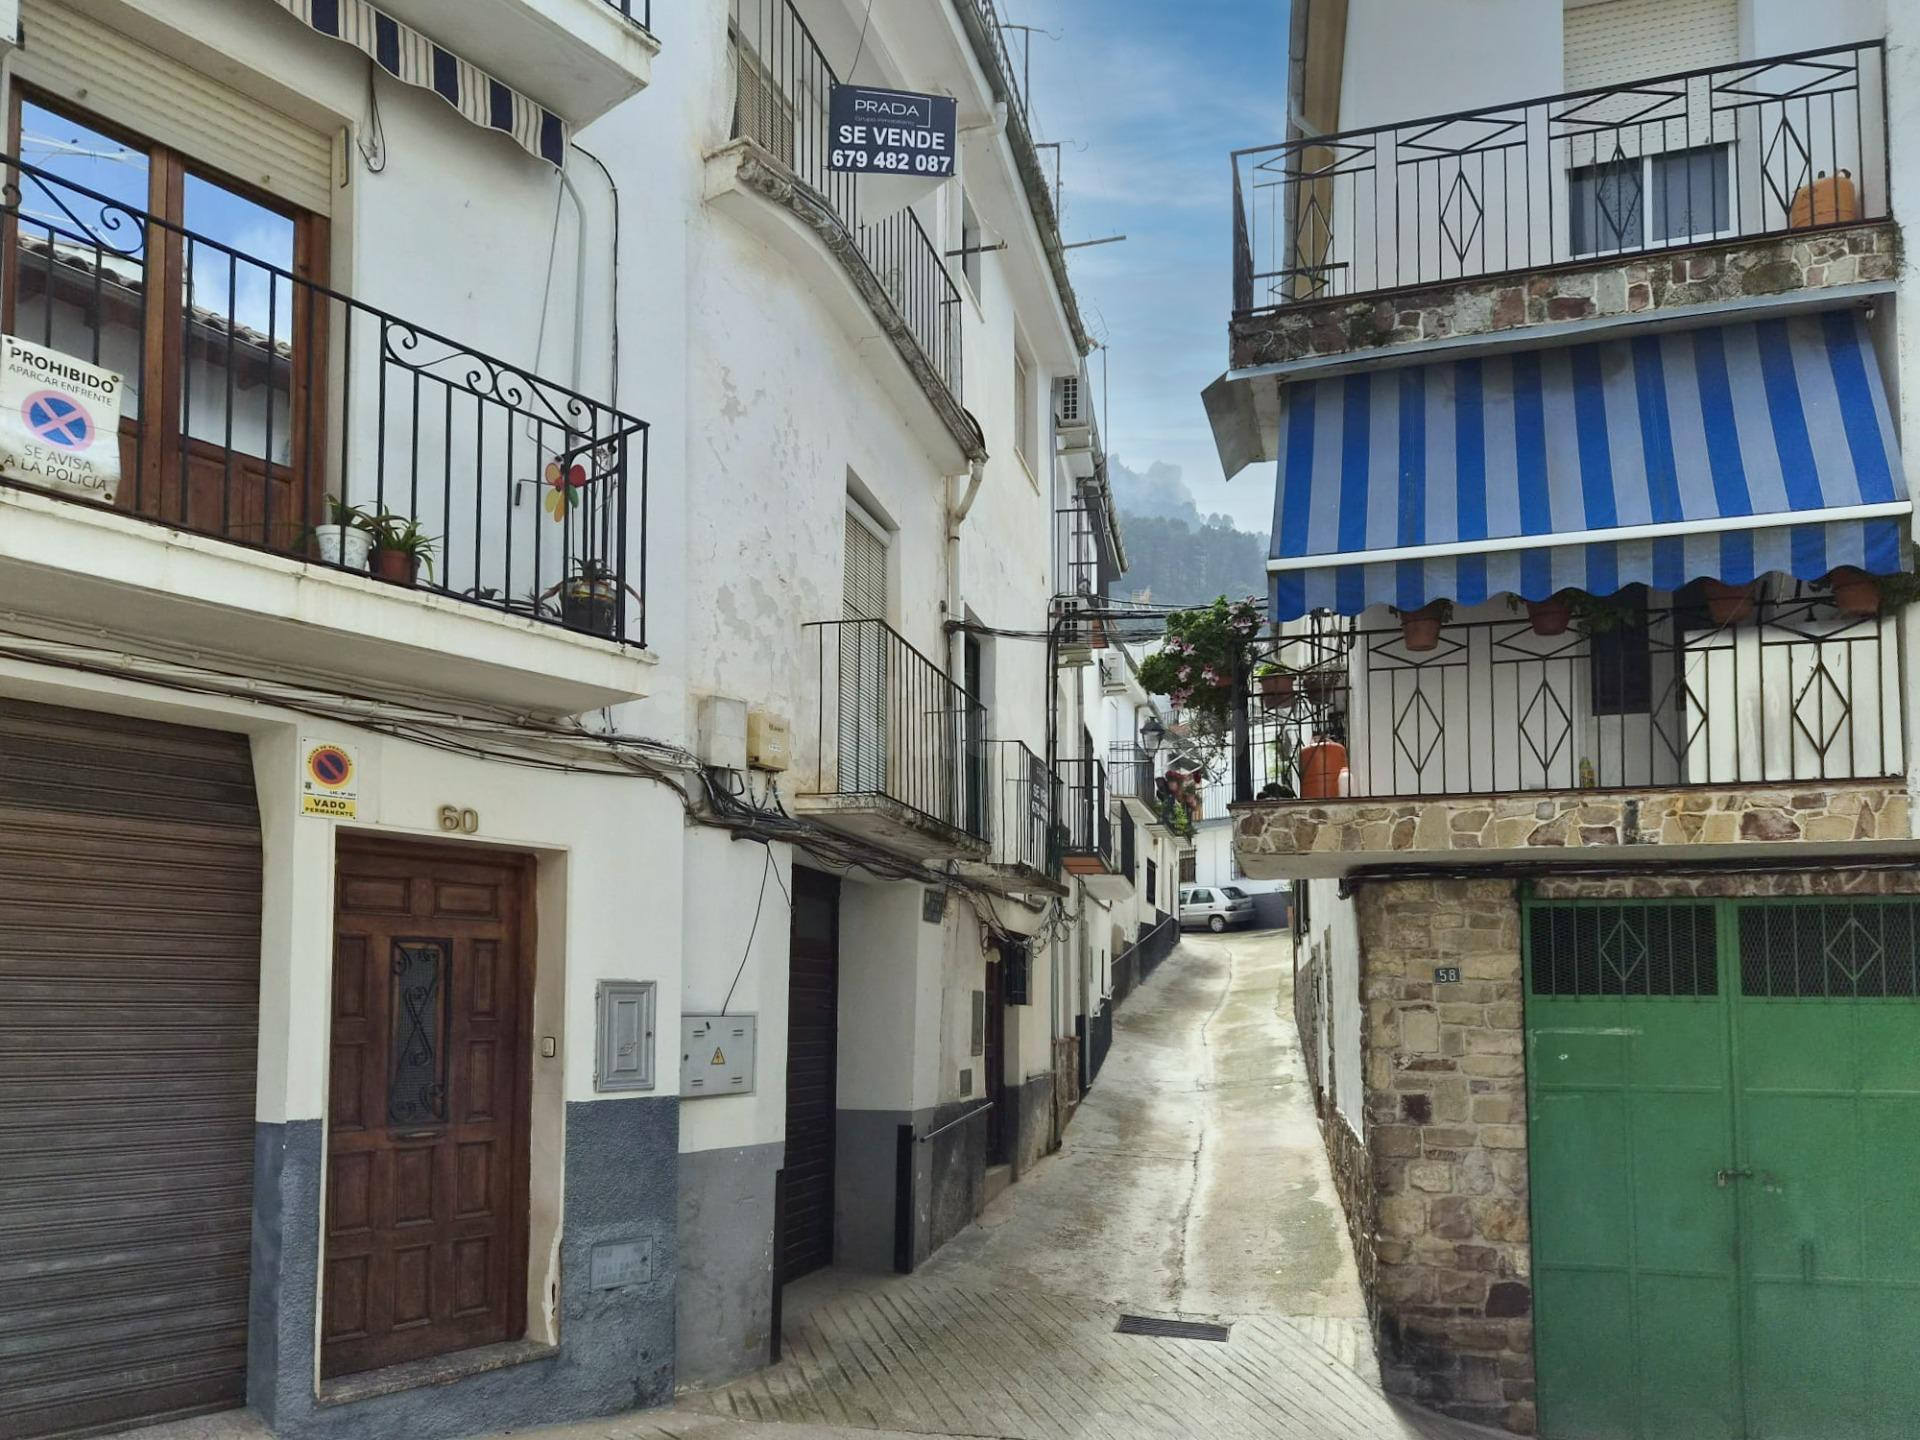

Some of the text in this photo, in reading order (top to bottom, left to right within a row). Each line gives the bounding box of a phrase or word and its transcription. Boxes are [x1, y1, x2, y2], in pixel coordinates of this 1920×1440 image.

[855, 99, 920, 117] PRADA
[839, 125, 945, 151] SE VENDE
[832, 149, 952, 173] 679 482 087
[10, 346, 115, 394] PROHIBIDO
[8, 363, 113, 407] APARCAR ENFRENTE
[4, 453, 16, 467] A
[21, 459, 41, 475] LA
[24, 444, 93, 473] SE AVISA
[305, 806, 354, 817] PERMANENTE
[313, 798, 347, 810] VADO
[437, 804, 479, 835] 60
[1439, 968, 1456, 982] 58
